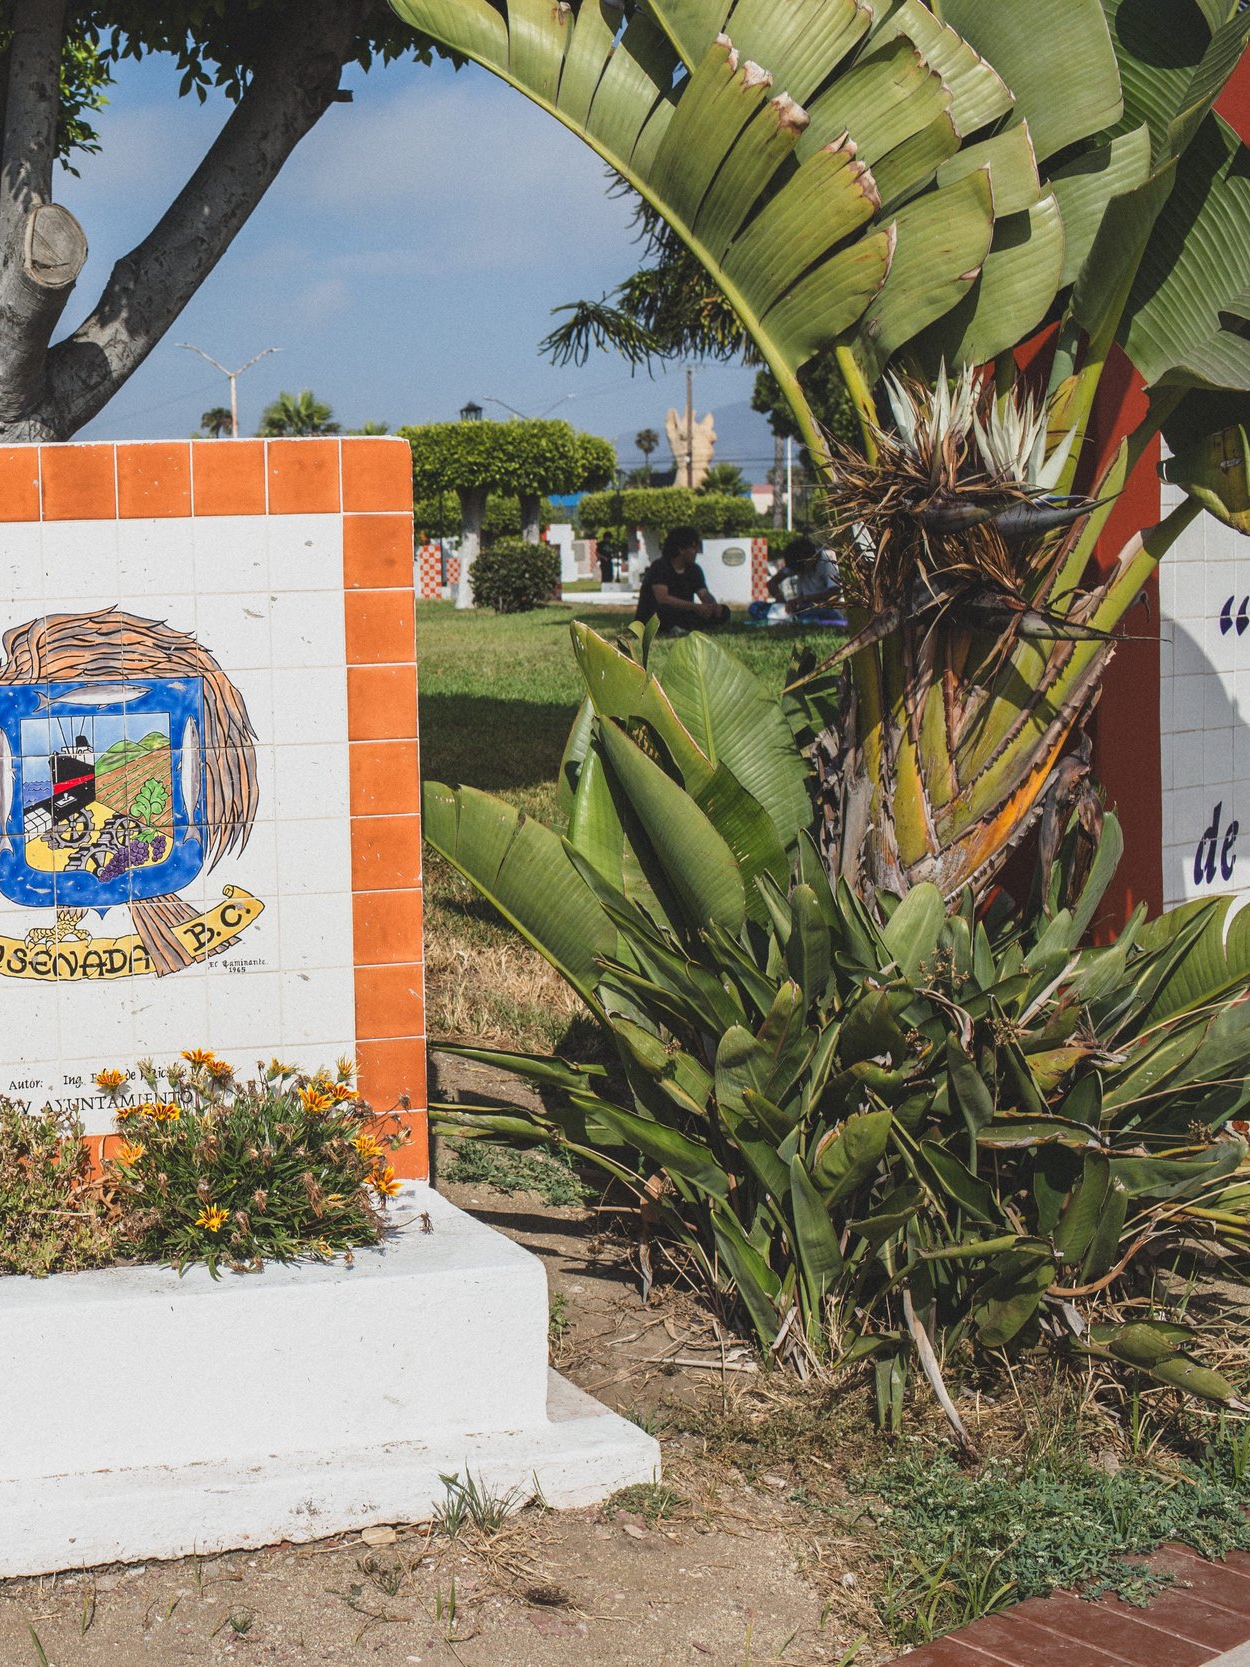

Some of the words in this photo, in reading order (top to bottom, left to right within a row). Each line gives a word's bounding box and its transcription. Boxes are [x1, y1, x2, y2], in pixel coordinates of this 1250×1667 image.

[1193, 801, 1240, 886] de
[8, 1079, 43, 1091] Autor:
[63, 1074, 86, 1089] Ing.
[42, 1089, 194, 1113] AYUNTAMIENTO
